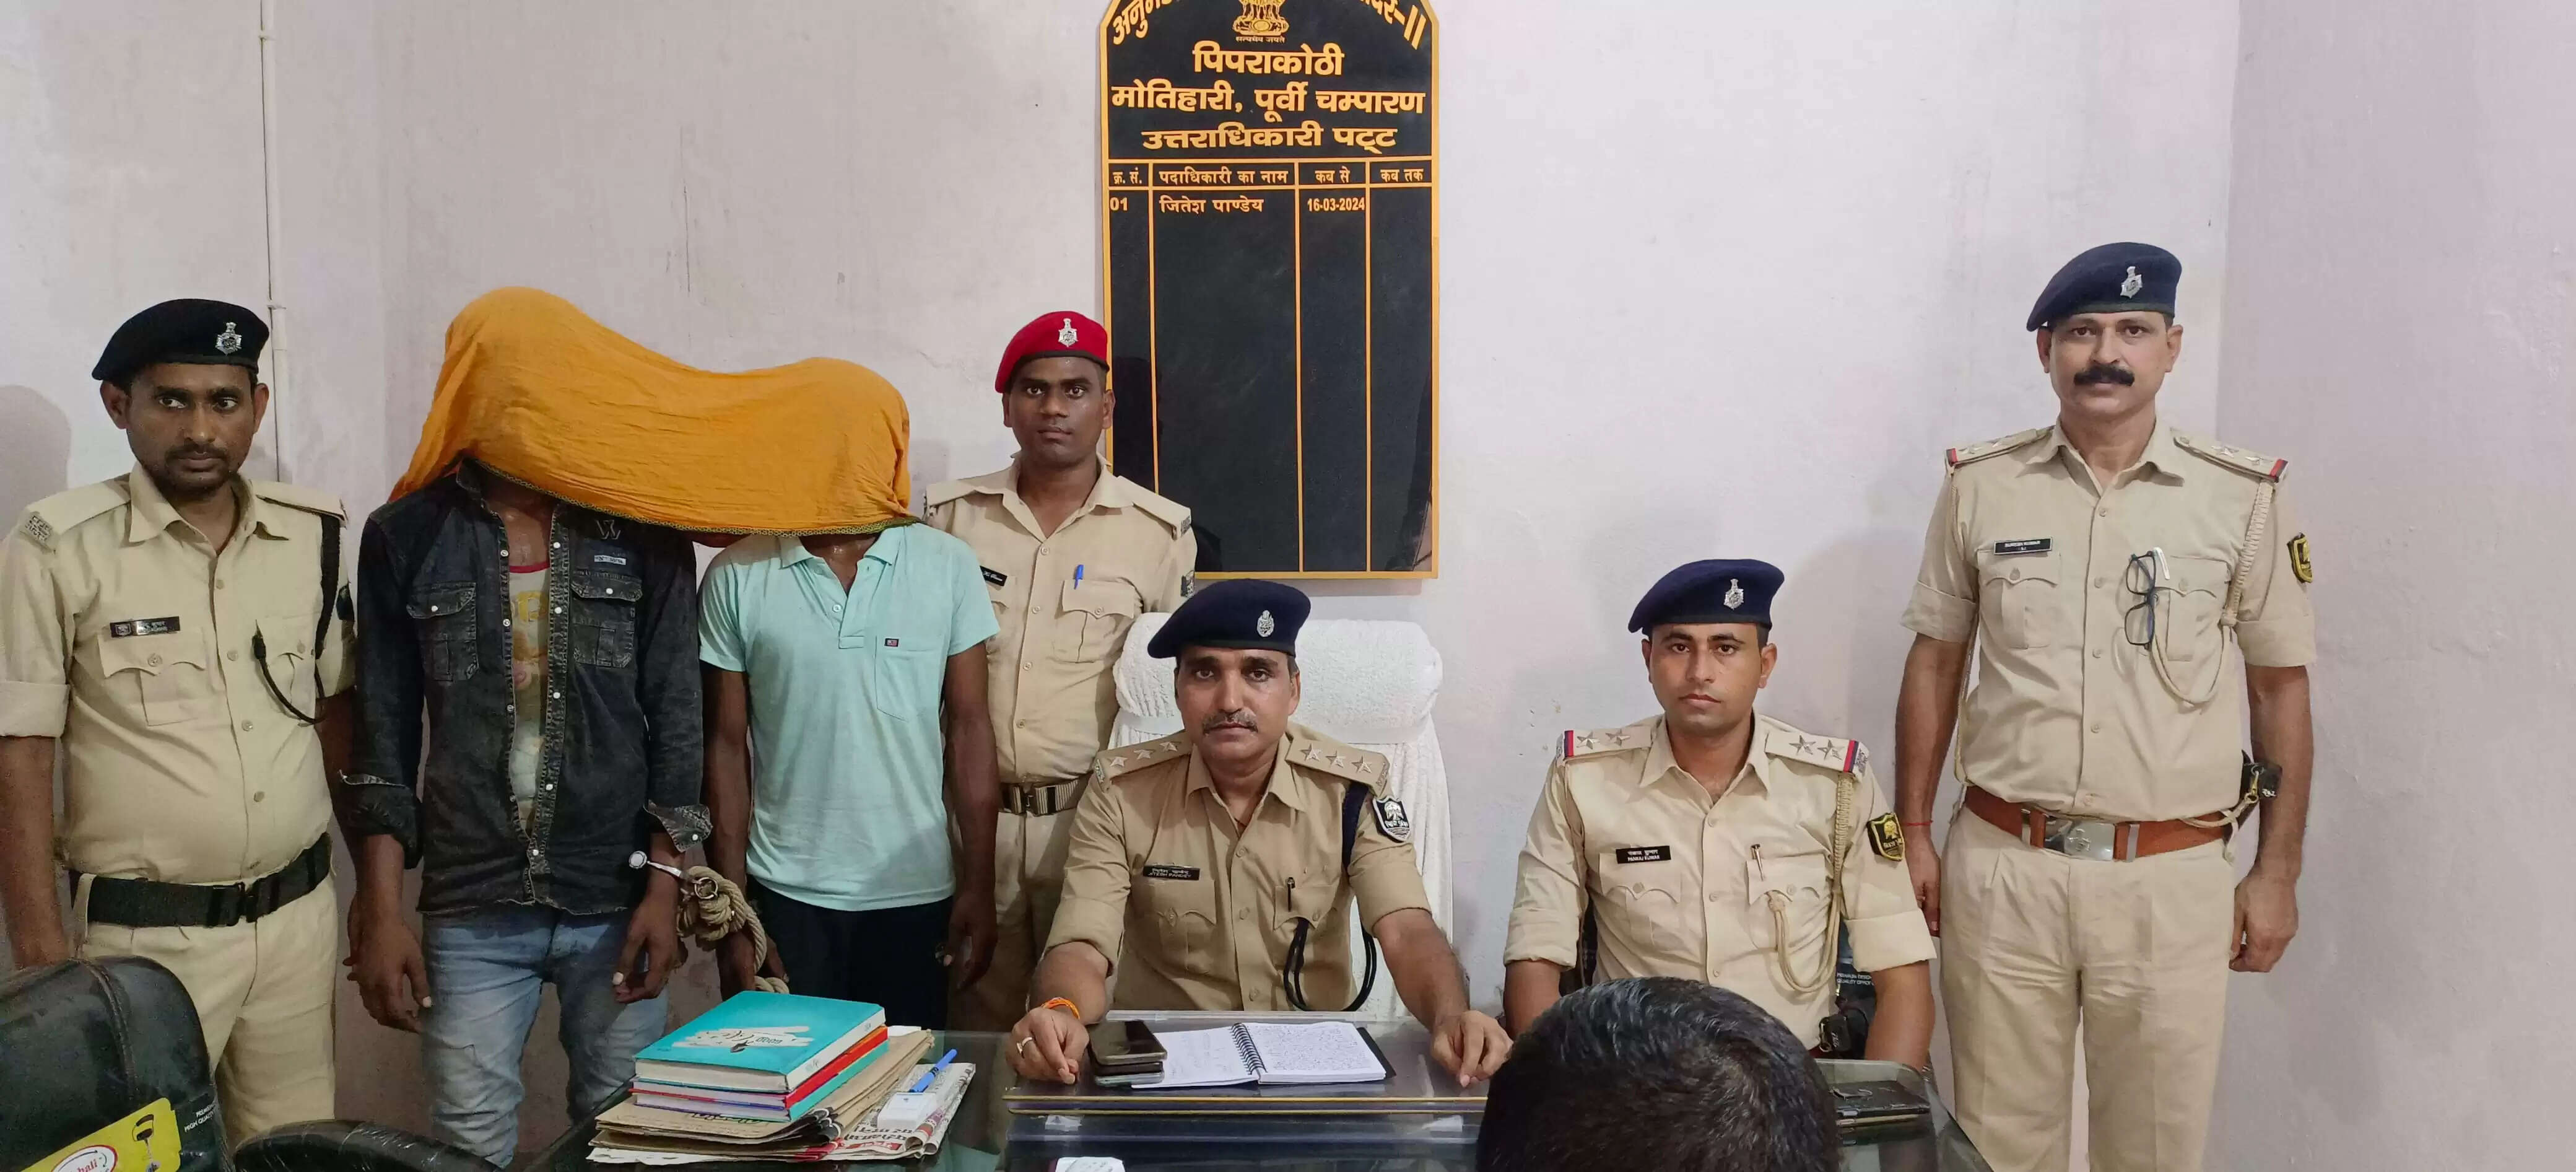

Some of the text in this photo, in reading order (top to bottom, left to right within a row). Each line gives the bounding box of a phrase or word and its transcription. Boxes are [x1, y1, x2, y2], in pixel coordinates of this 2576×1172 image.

[1192, 40, 1345, 76] पिपराकोठी
[1112, 79, 1426, 123] मोतिहारी, पूर्वी चम्पारण
[1141, 120, 1324, 149] उत्तराधिकारी
[1129, 167, 1142, 184] सं.
[1159, 166, 1289, 185] पदाधिकारी का नाम
[1315, 165, 1351, 183] कब से
[1380, 168, 1424, 183] कब तक
[1110, 197, 1128, 211] 01
[1159, 195, 1264, 214] जितेश पाण्डेय
[1307, 196, 1365, 212] 16-03-2024
